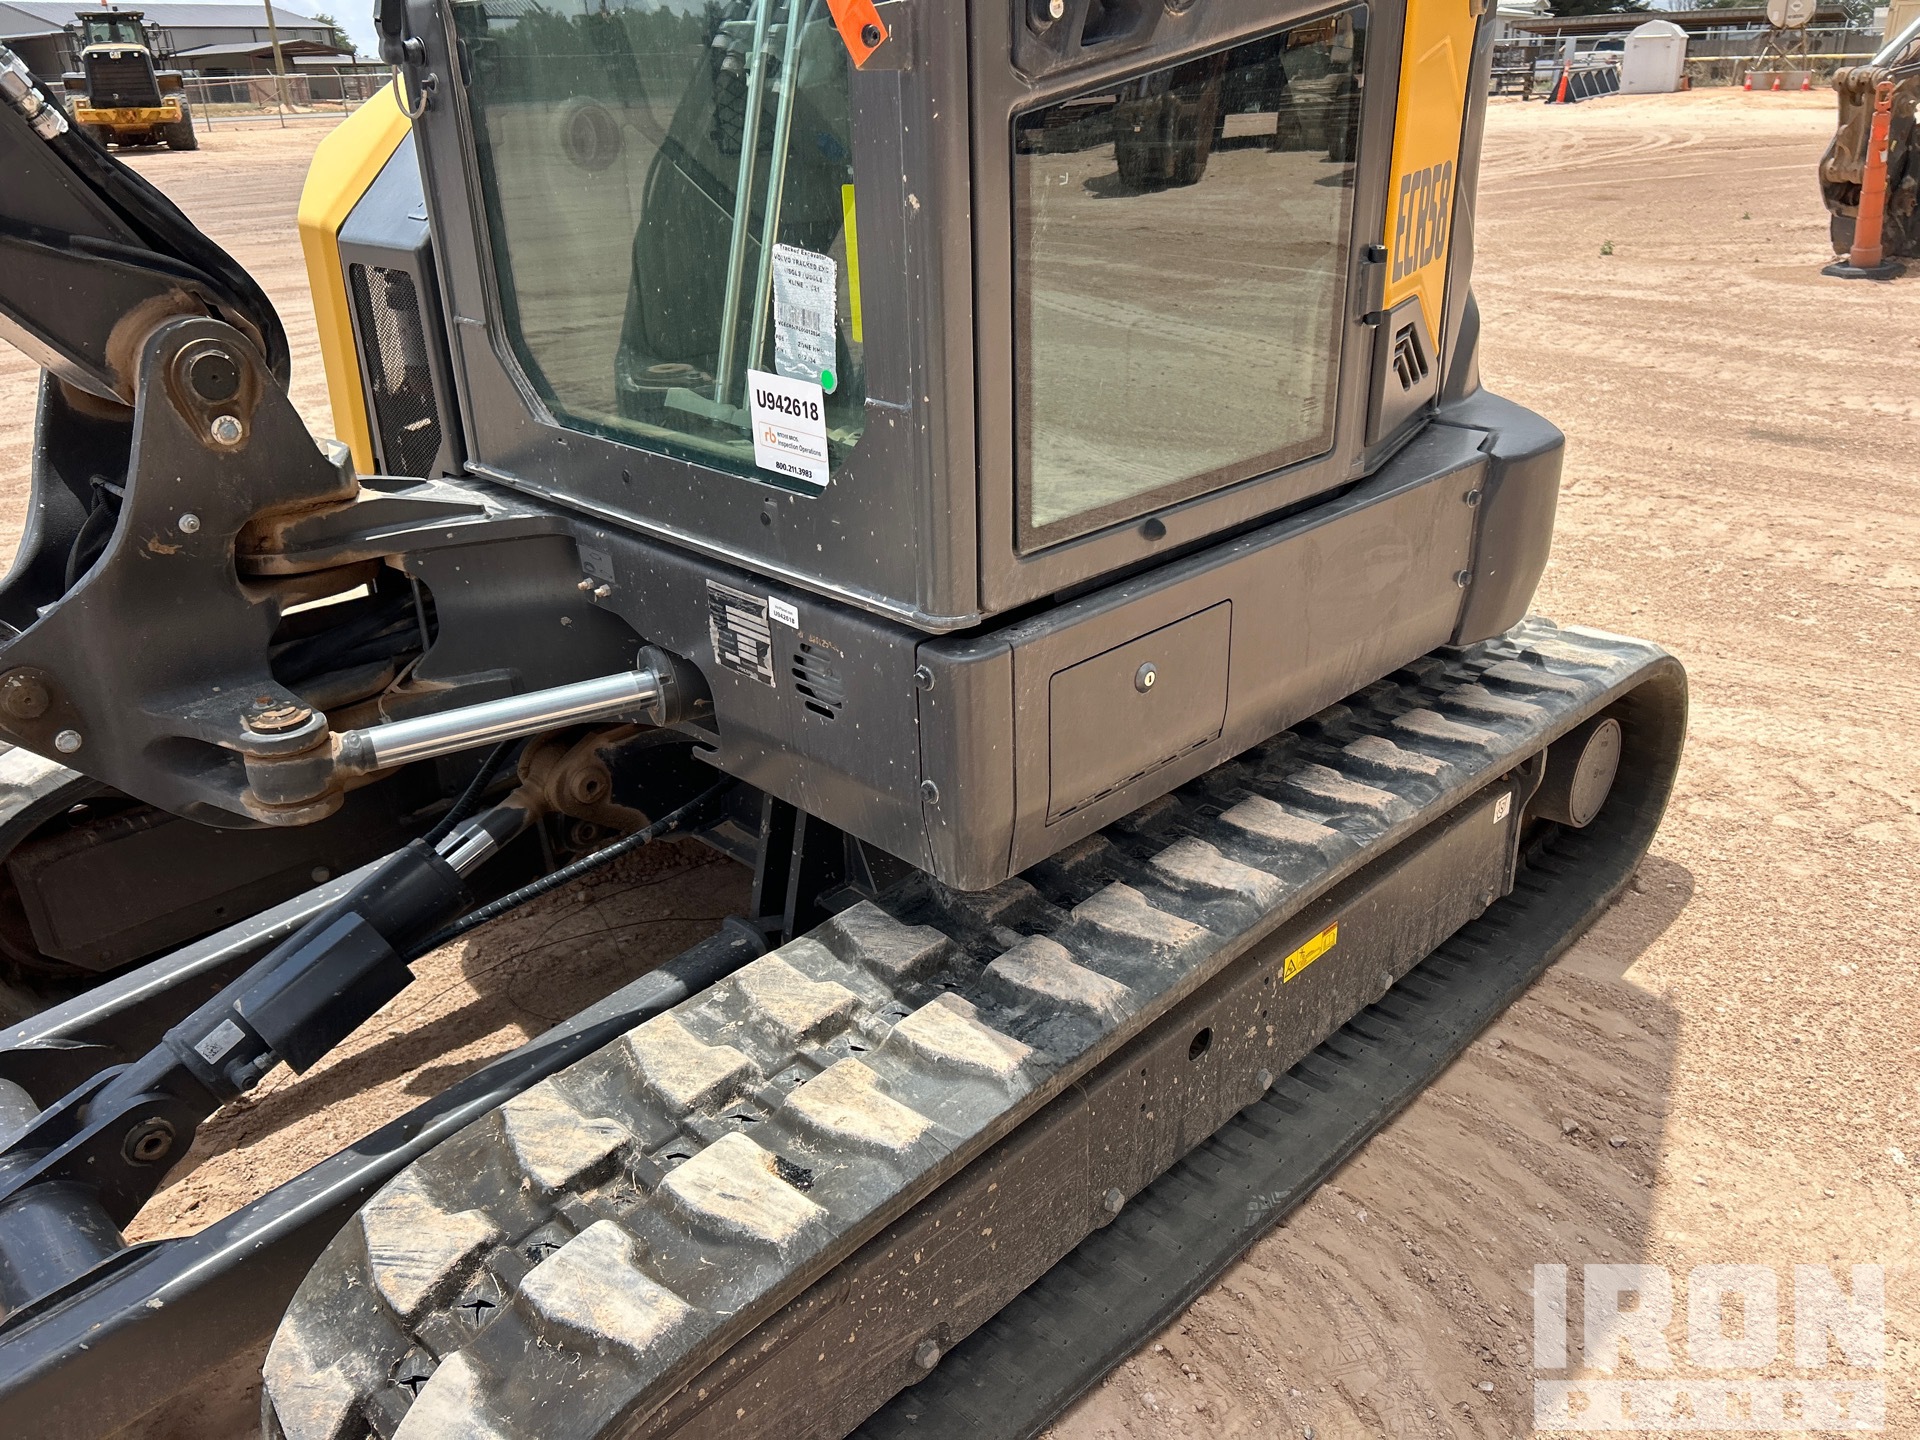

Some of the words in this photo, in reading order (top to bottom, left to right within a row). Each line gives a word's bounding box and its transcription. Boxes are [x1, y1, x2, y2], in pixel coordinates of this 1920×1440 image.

[109, 51, 122, 59] CAT
[1391, 160, 1453, 284] ECR58
[756, 388, 819, 421] U942618
[764, 426, 777, 444] rb
[777, 439, 799, 451] Inspection
[798, 444, 822, 457] Operations
[775, 461, 813, 479] 800.211.3983
[773, 610, 796, 624] U942618
